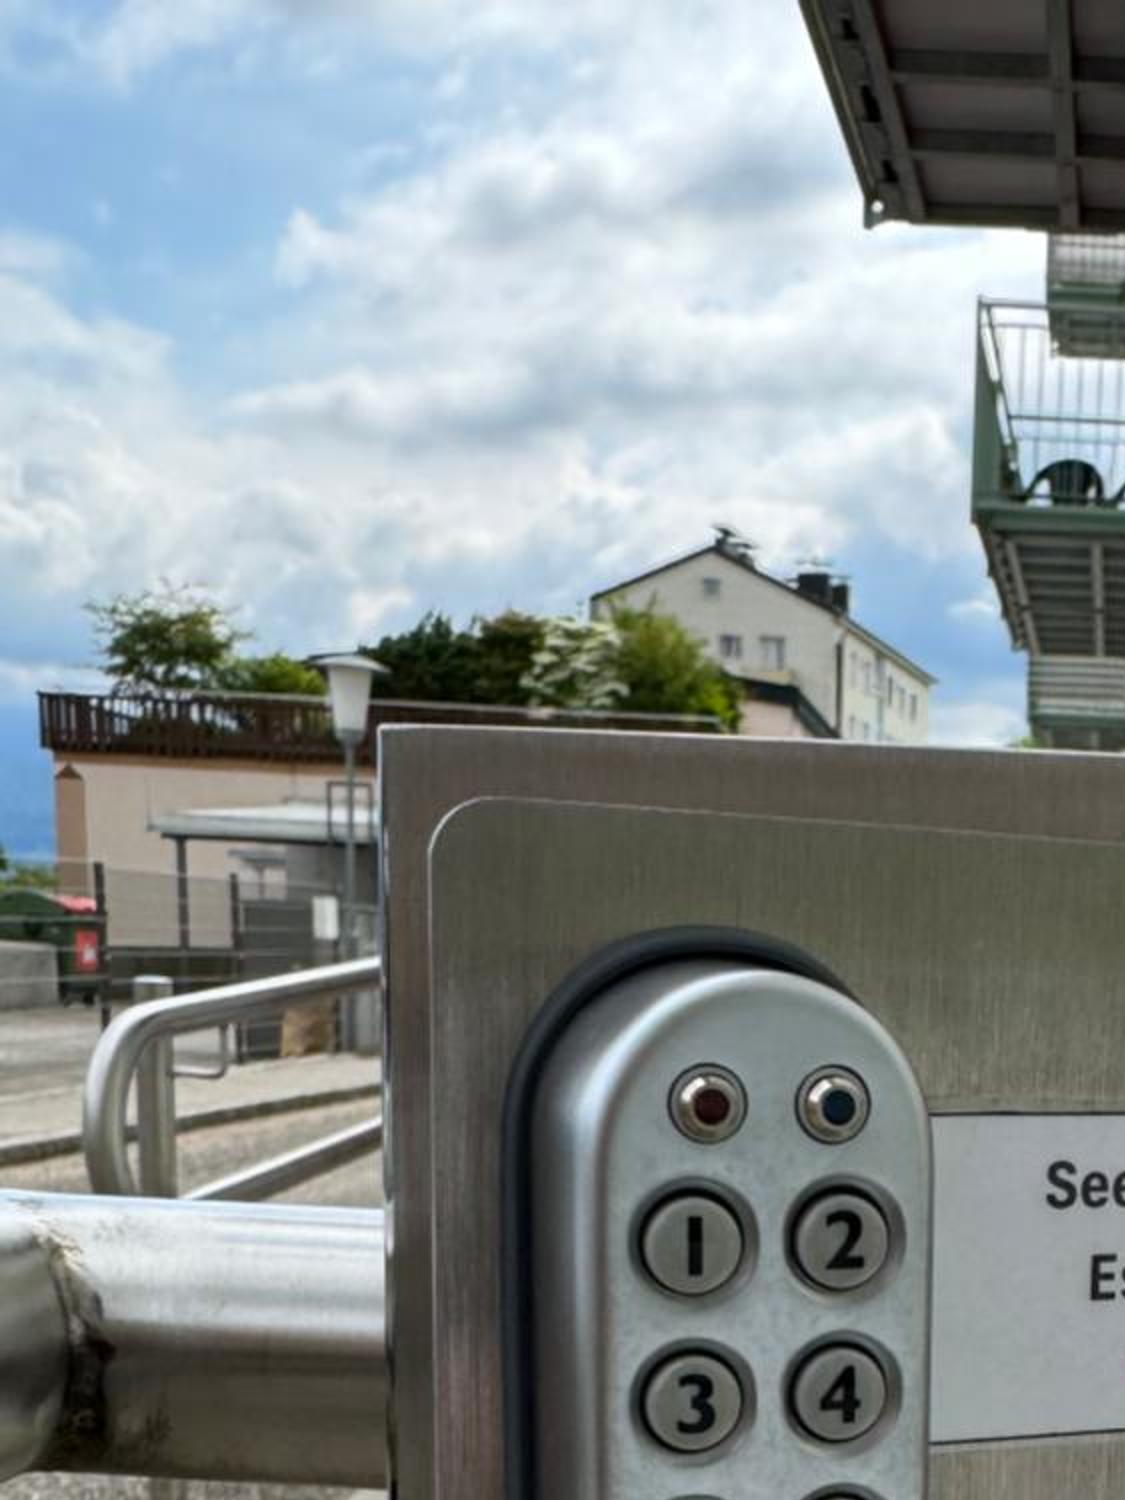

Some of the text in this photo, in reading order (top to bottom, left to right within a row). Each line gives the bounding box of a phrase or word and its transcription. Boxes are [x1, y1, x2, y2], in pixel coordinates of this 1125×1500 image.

[687, 1216, 704, 1276] 1
[824, 1209, 866, 1270] 2
[676, 1373, 717, 1434] 3
[819, 1364, 862, 1424] 4
